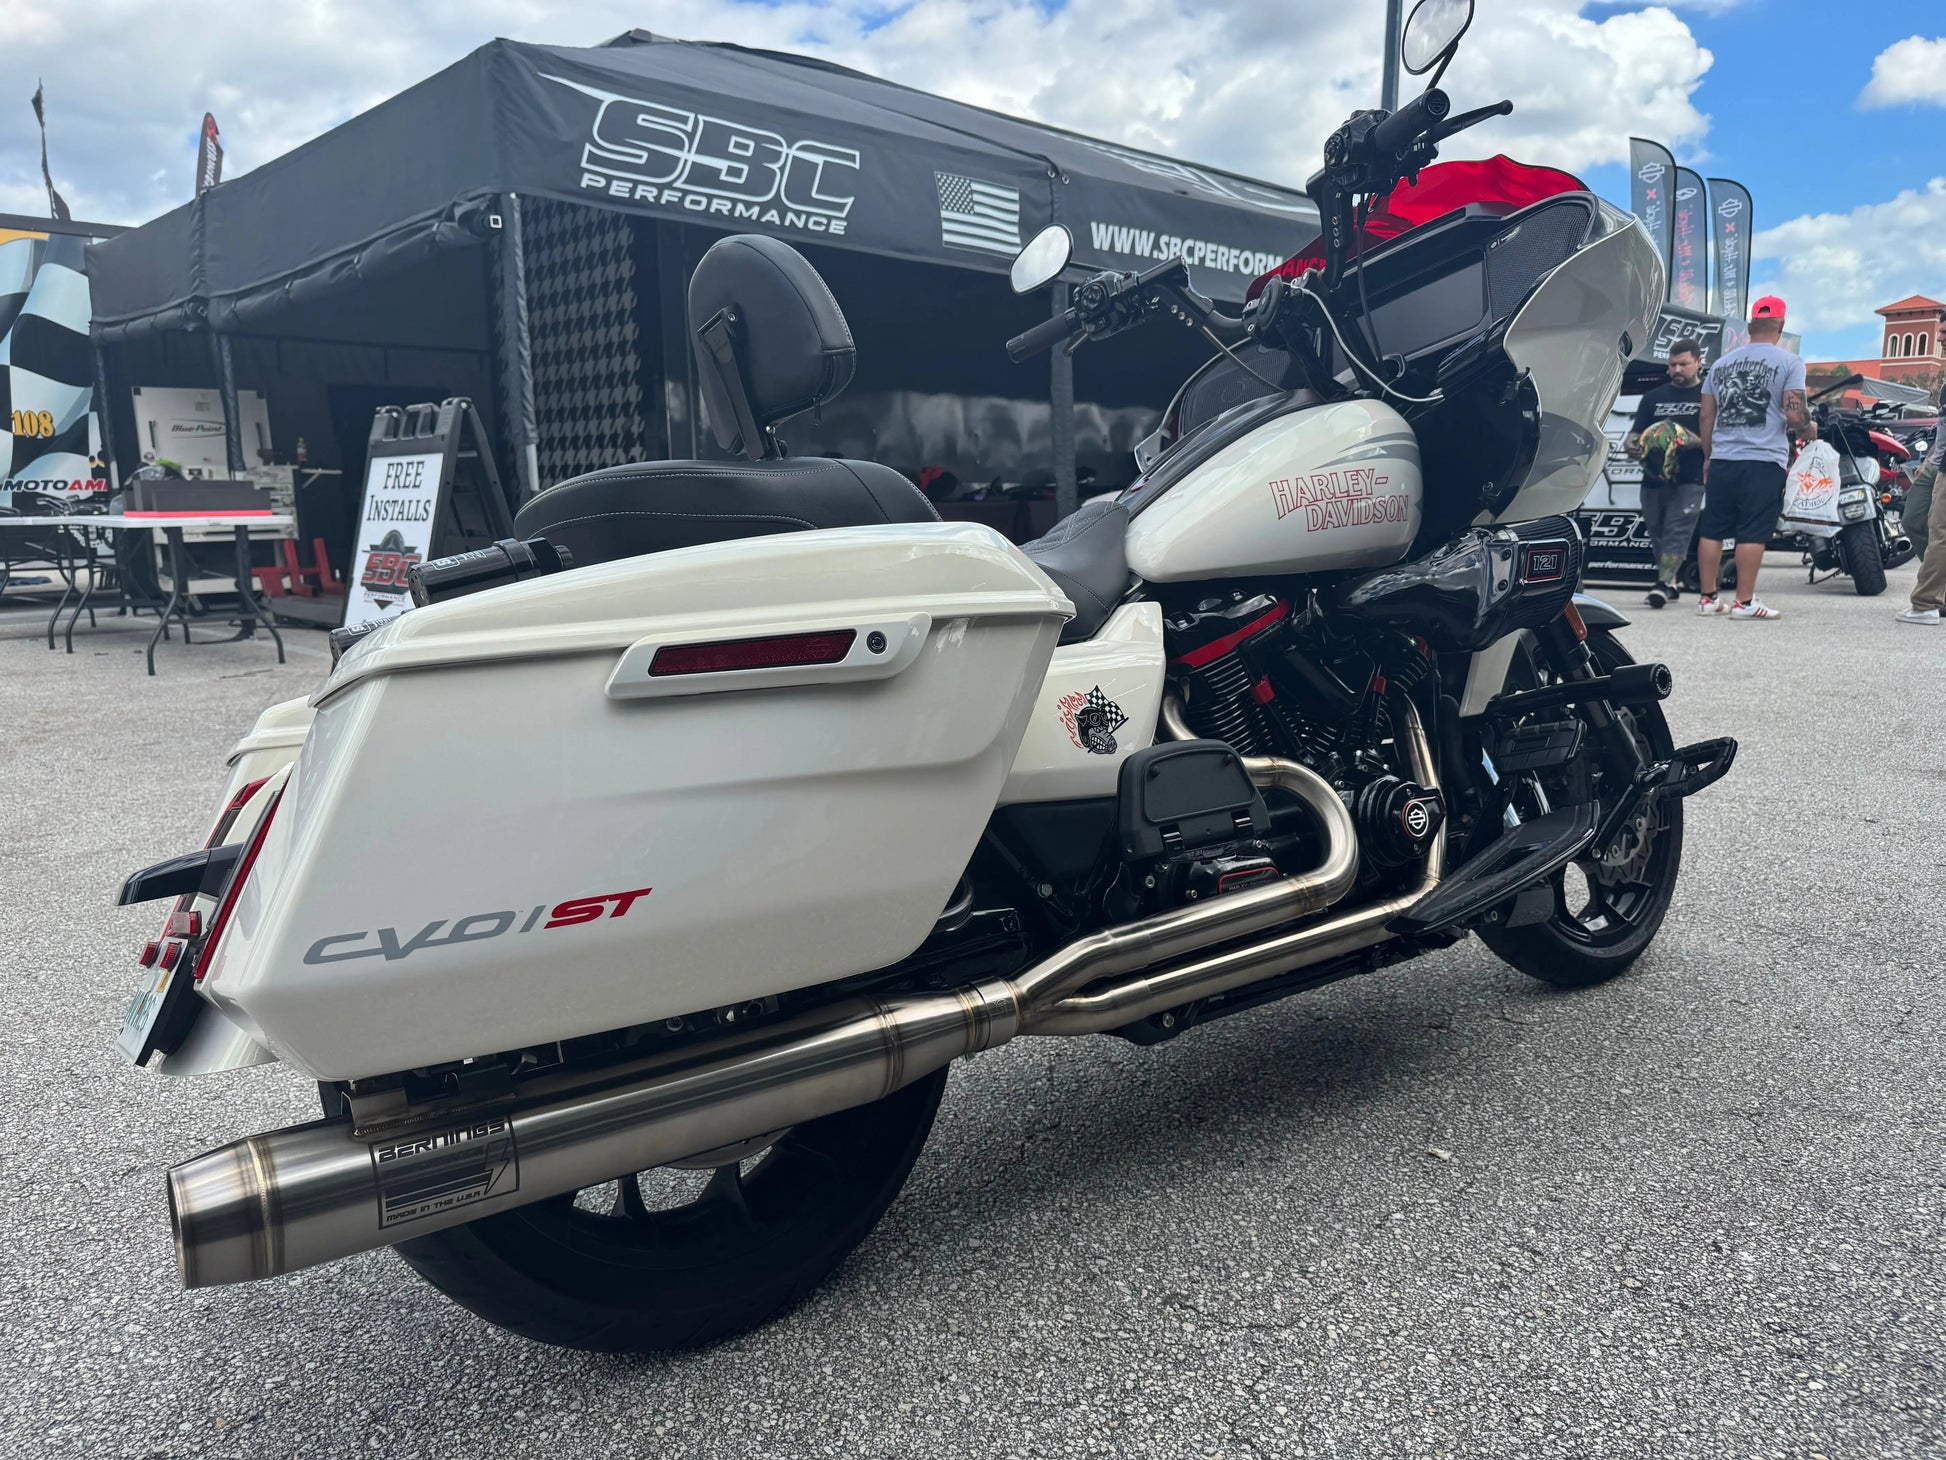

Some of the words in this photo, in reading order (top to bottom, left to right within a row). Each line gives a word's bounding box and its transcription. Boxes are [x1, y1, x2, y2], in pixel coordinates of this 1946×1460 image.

[578, 96, 860, 218] SBC
[579, 172, 848, 235] PERFORMANCE
[11, 409, 55, 438] 108
[3, 479, 108, 492] MOTOAM
[383, 460, 426, 490] FREE
[366, 494, 431, 522] INSTALLS
[1268, 468, 1389, 520] HARLEY-
[1304, 494, 1409, 532] DAVIDSON
[360, 552, 423, 587] SBC
[1533, 554, 1558, 571] 121
[302, 910, 517, 965] CVO
[543, 887, 654, 930] ST
[378, 1118, 507, 1164] BERNINGS
[386, 1208, 418, 1222] MADE
[420, 1204, 431, 1213] IN
[433, 1198, 454, 1209] THE
